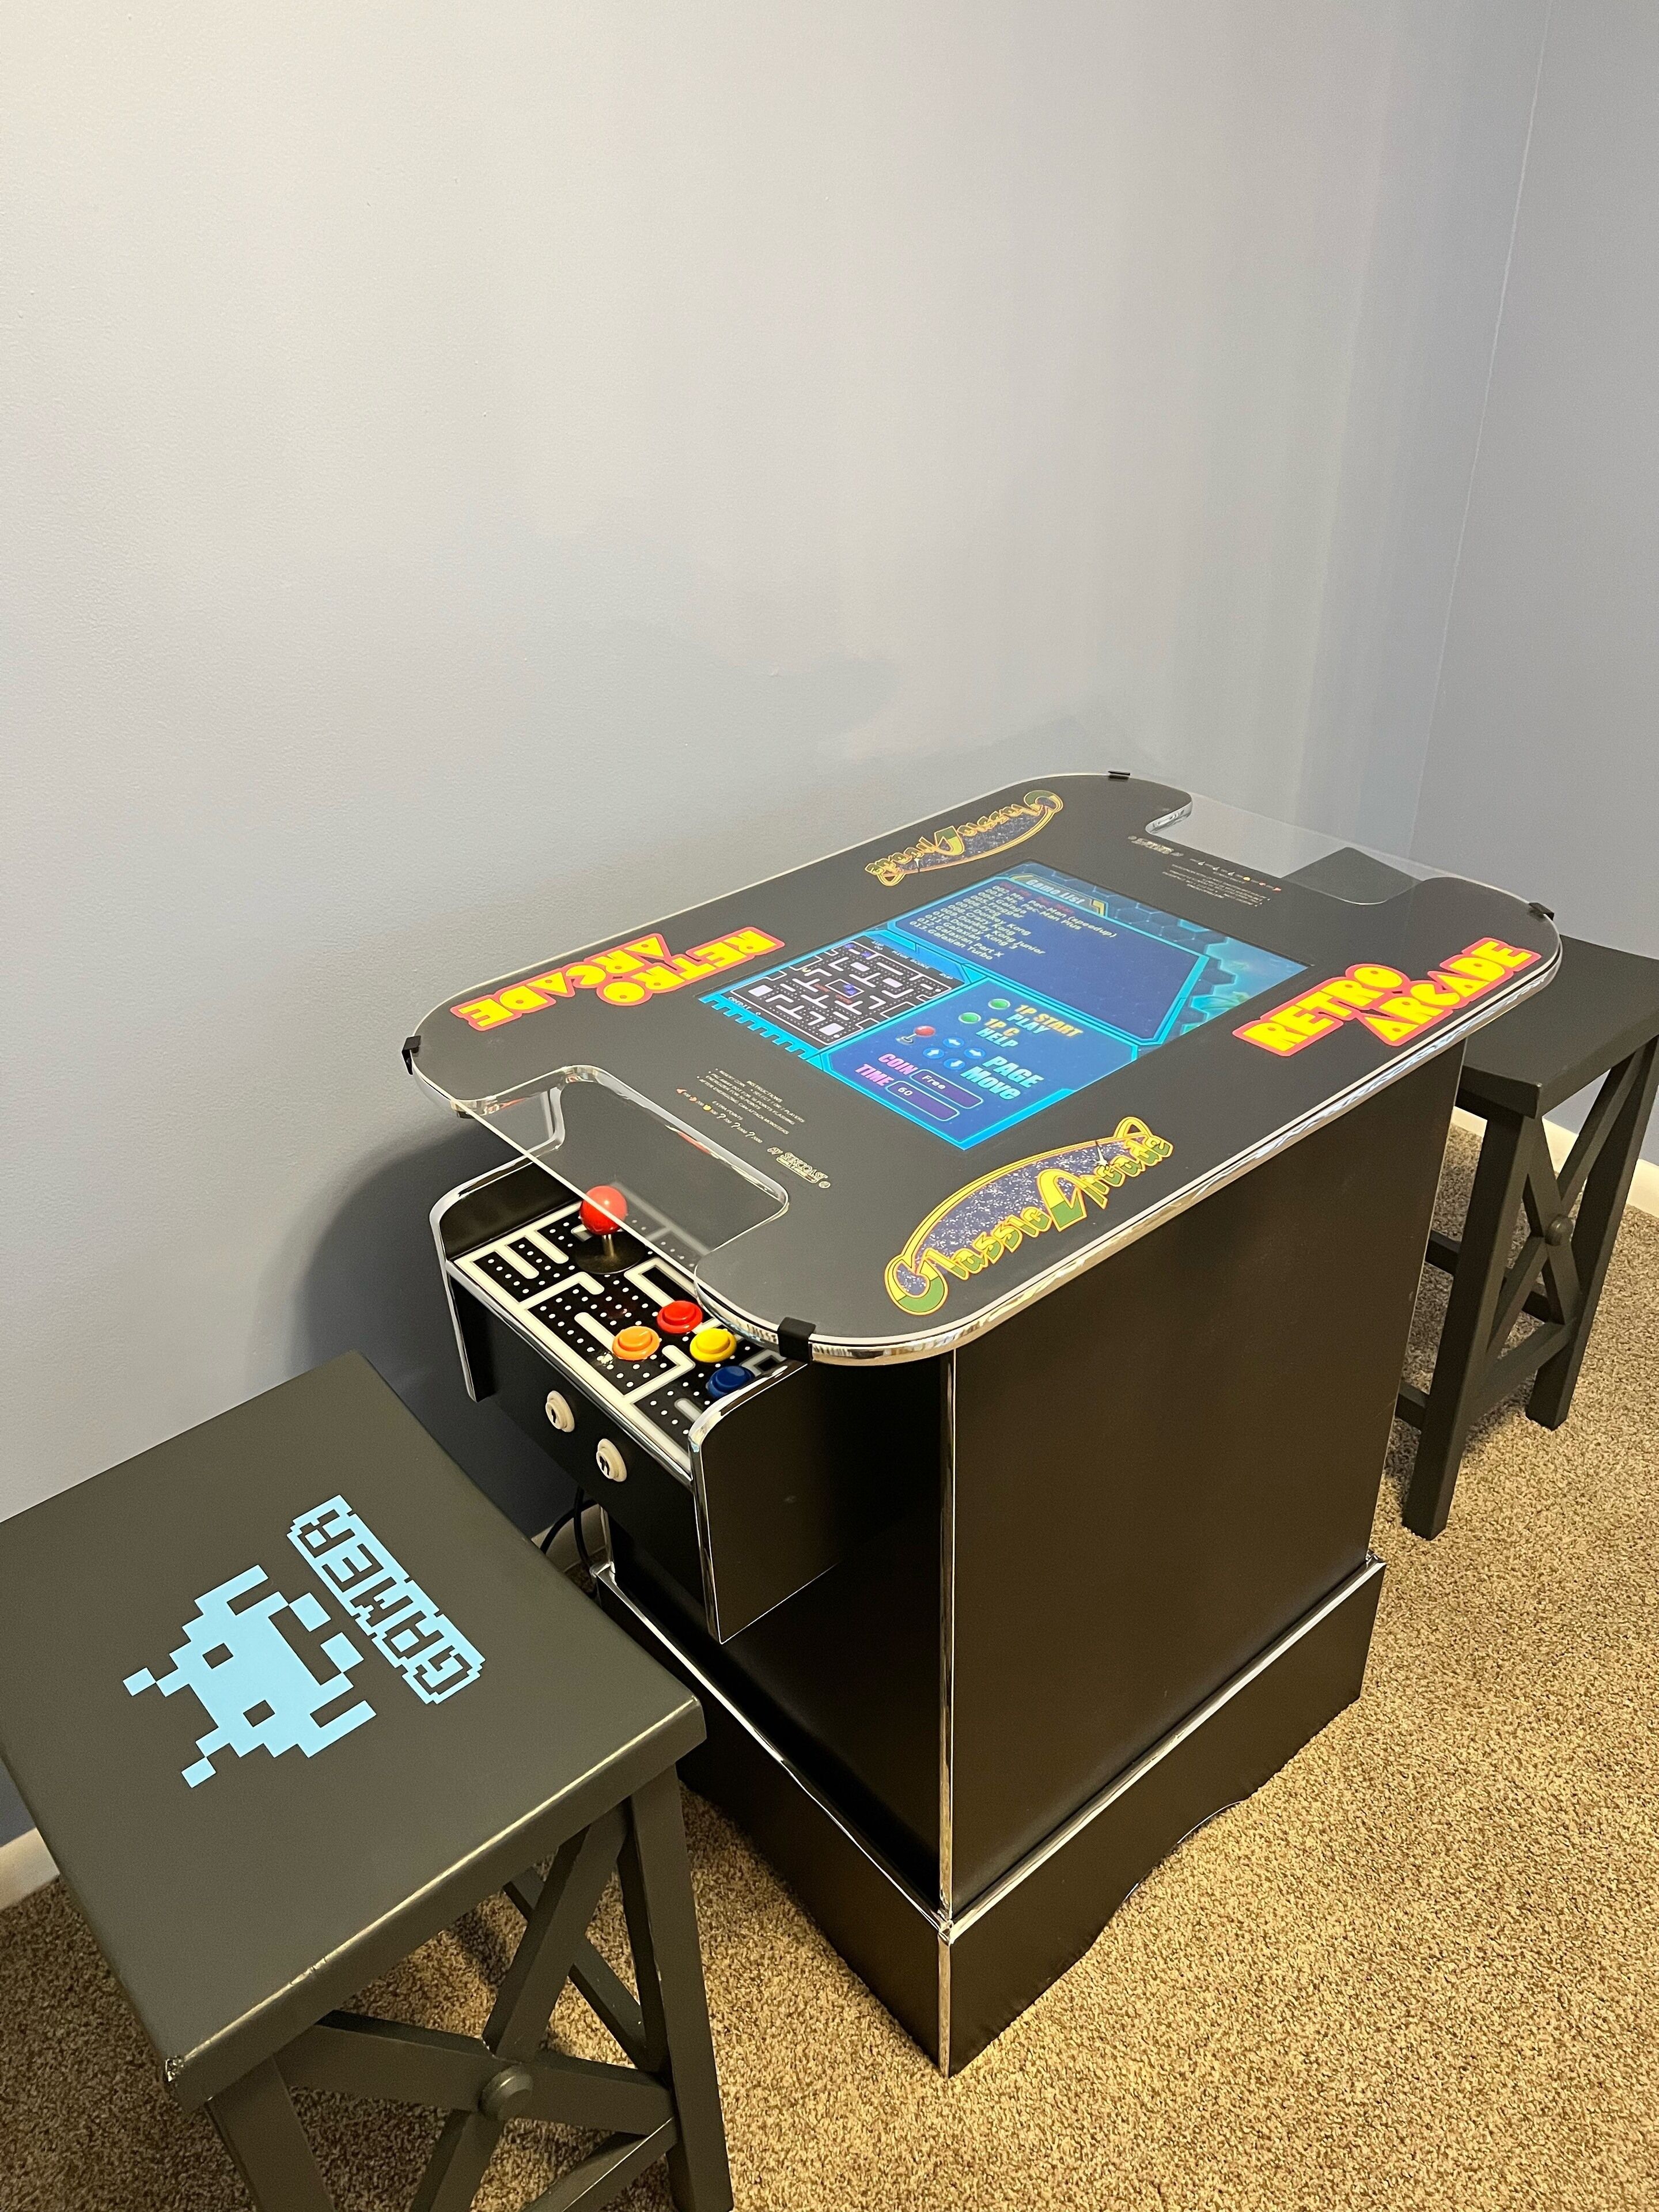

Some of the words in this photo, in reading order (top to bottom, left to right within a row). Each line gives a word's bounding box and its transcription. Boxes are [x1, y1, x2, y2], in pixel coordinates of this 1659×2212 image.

[1026, 879, 1060, 895] Game
[1059, 892, 1085, 904] List
[991, 923, 1016, 935] Kong
[991, 930, 1016, 942] Kong
[1007, 923, 1031, 935] Kong
[1061, 919, 1082, 930] Plus
[974, 943, 994, 953] Part
[984, 934, 1008, 946] Kong
[967, 946, 993, 960] Turbo
[600, 929, 781, 1004] RETRO
[455, 934, 668, 1029] ARCADE
[1361, 940, 1536, 1044] ARCADE
[1014, 1005, 1037, 1014] 1P
[1033, 1013, 1084, 1036] START
[1238, 965, 1406, 1053] RETRO
[984, 1018, 1006, 1028] 1P
[1003, 1028, 1020, 1037] C
[1006, 1013, 1051, 1033] PLAY
[976, 1028, 1018, 1047] HELP
[855, 1064, 895, 1086] TIME
[897, 1087, 913, 1096] 60
[878, 1054, 918, 1075] COIN
[922, 1075, 945, 1090] Free
[982, 1056, 1044, 1088] PAGE
[885, 1206, 1052, 1315] Classic
[1037, 1116, 1174, 1232] Arcade
[290, 1499, 483, 1700] GAMER
